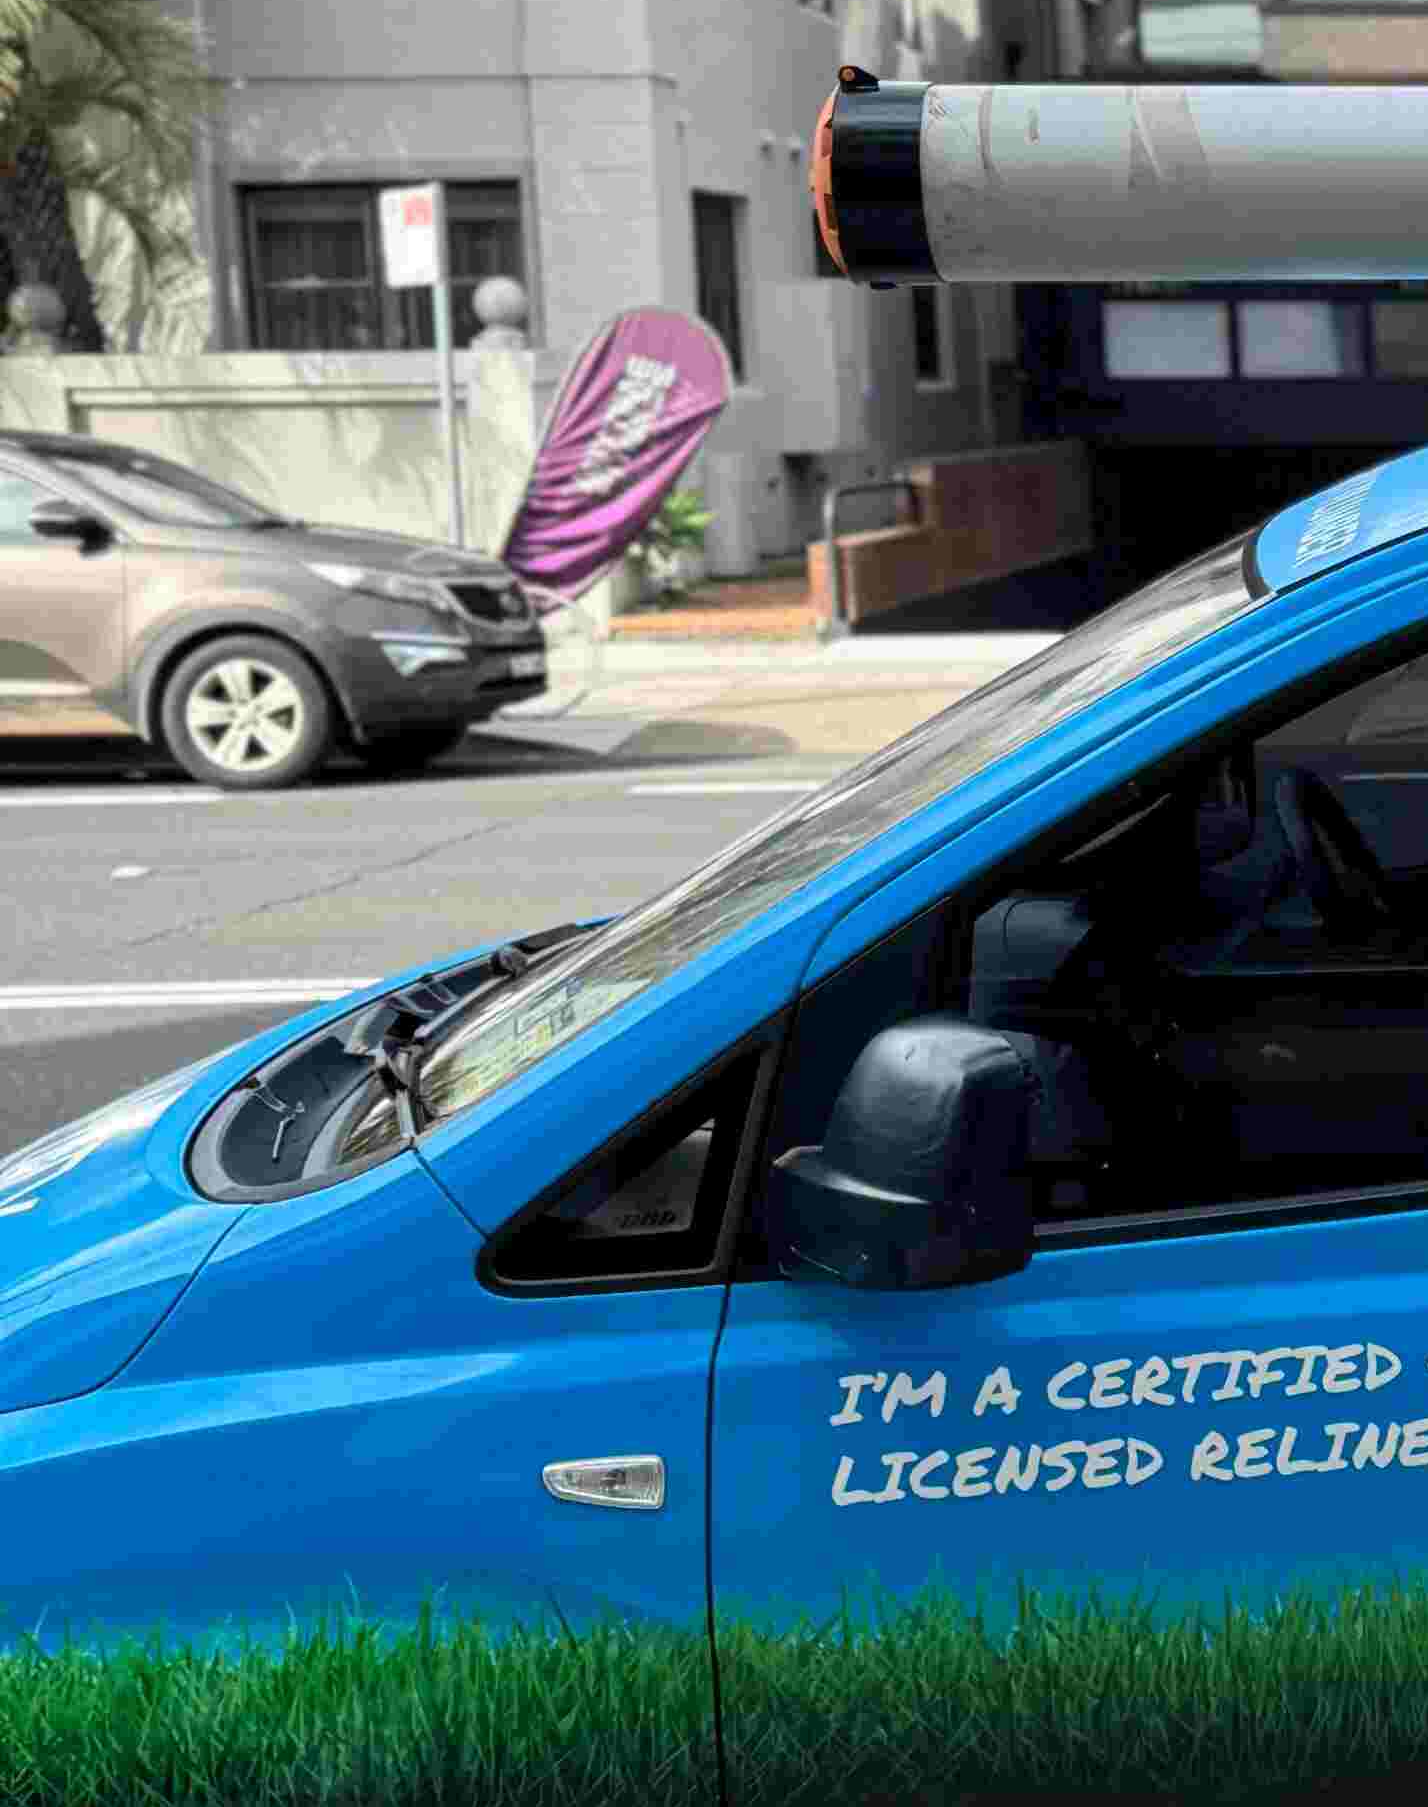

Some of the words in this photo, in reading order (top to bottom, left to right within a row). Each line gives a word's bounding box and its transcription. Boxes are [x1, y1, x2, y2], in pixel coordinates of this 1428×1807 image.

[829, 1370, 947, 1427] I'M
[973, 1365, 1022, 1416] A
[1046, 1342, 1403, 1410] CERTIFIED
[831, 1436, 1165, 1507] LICENSED
